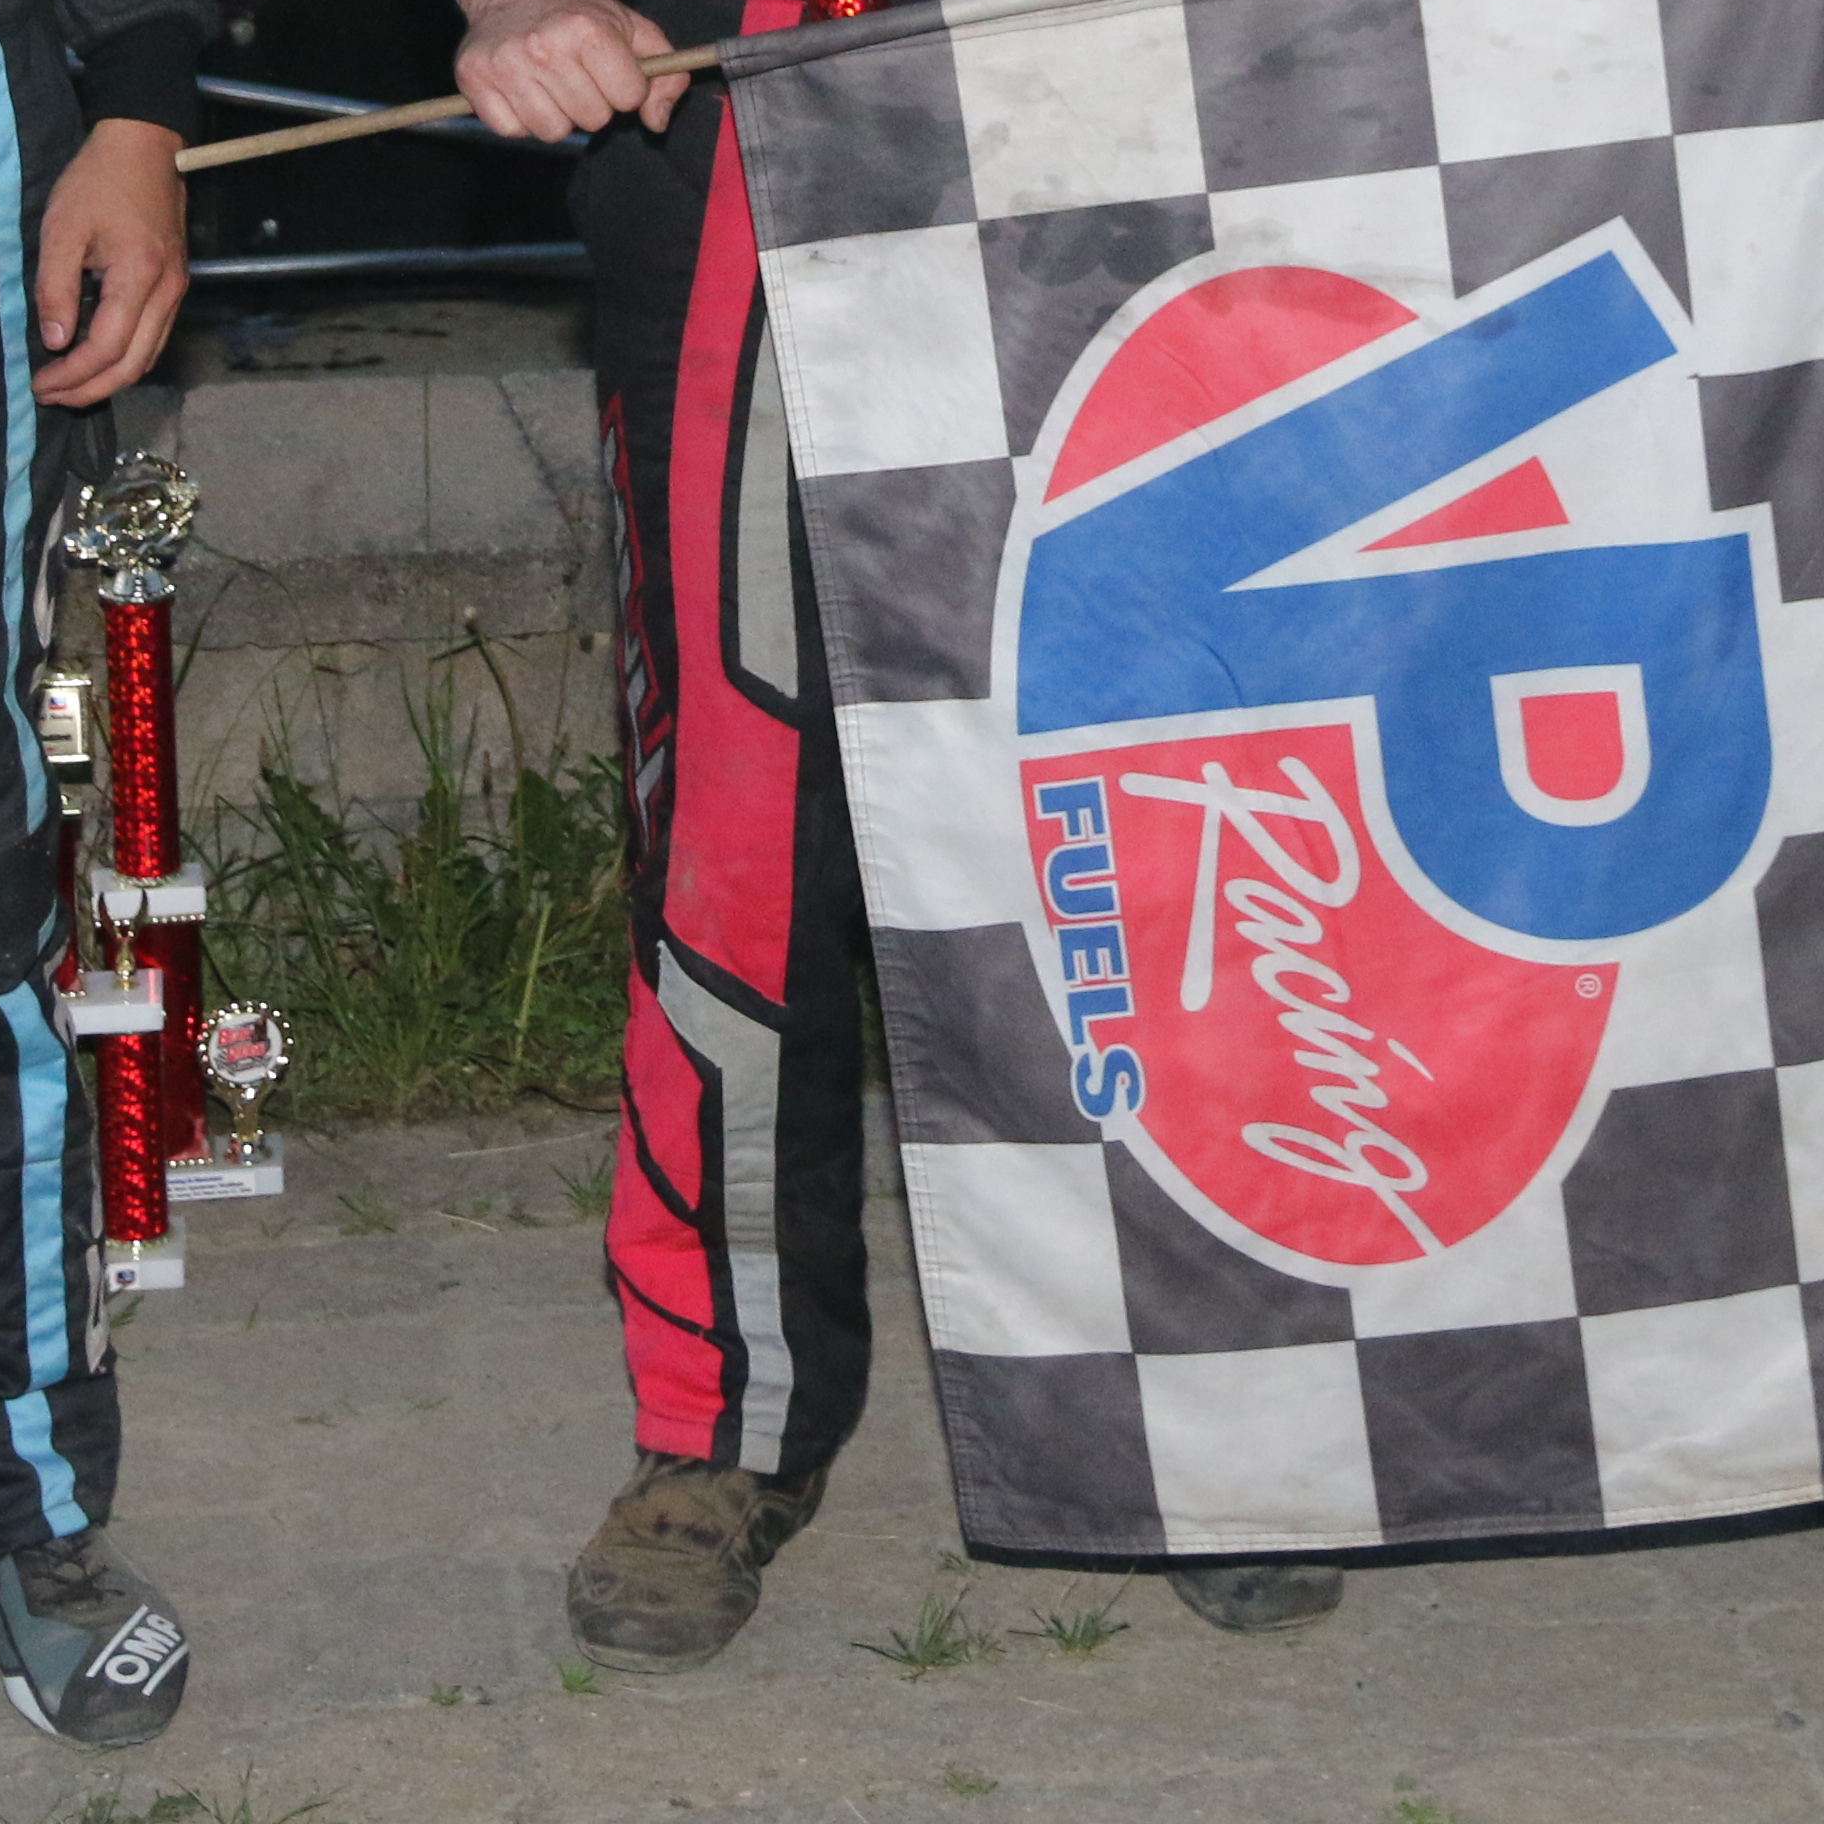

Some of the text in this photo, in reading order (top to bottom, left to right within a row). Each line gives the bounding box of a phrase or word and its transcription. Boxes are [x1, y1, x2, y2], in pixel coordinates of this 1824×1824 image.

[1017, 249, 1774, 943] VP
[1033, 779, 1145, 1122] FUELS
[1119, 754, 1448, 1254] Racing
[104, 1612, 184, 1688] OMP
